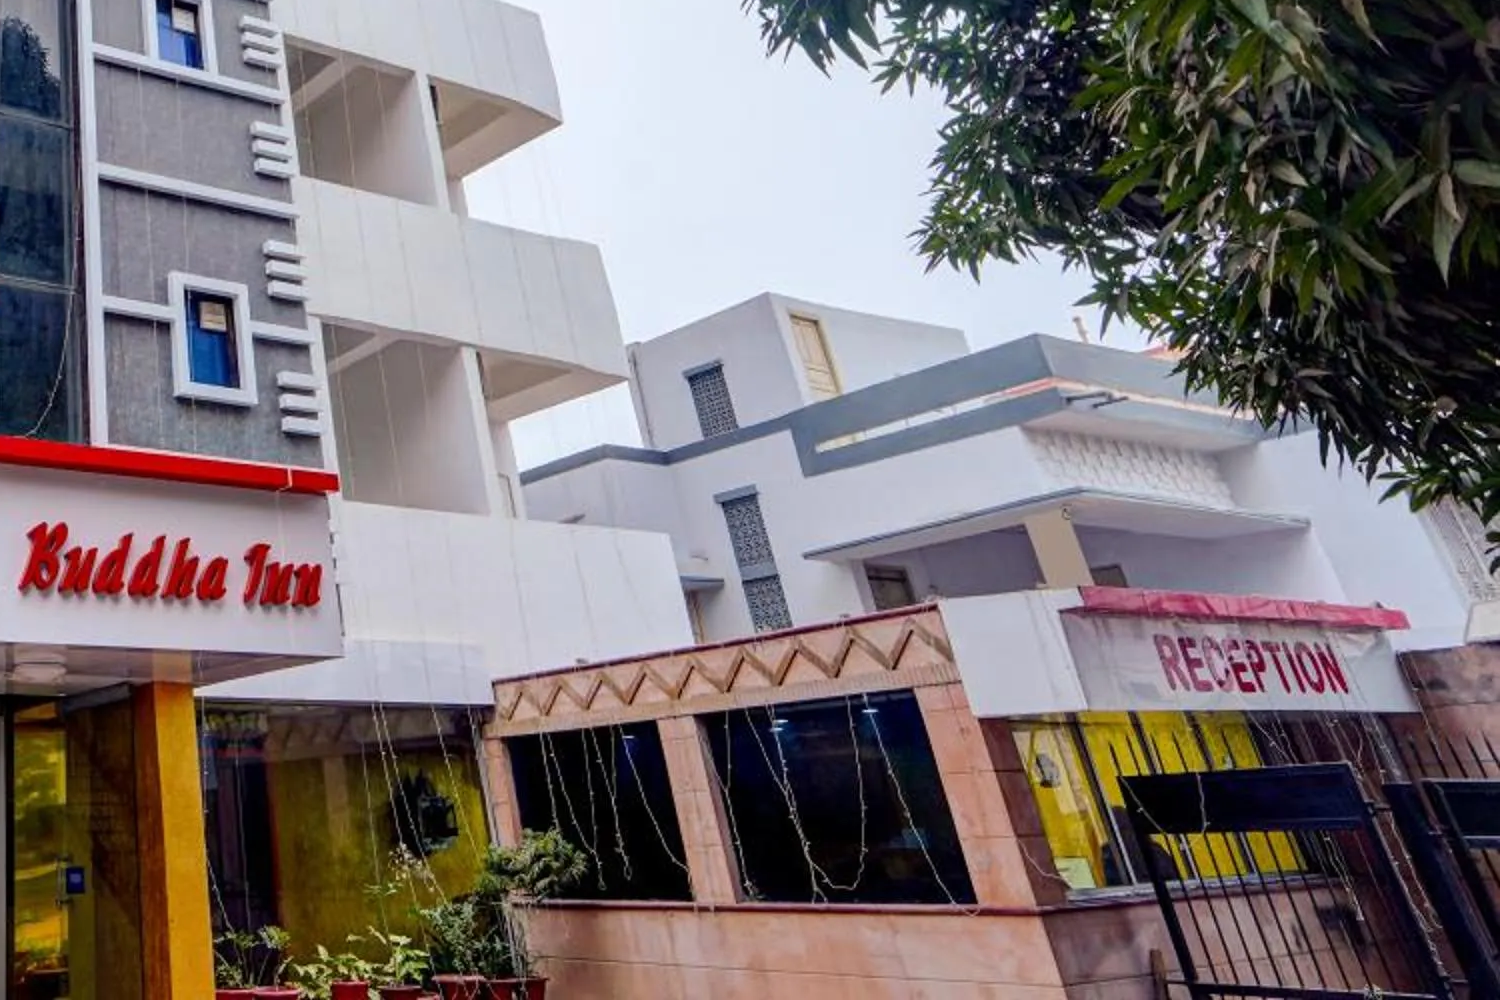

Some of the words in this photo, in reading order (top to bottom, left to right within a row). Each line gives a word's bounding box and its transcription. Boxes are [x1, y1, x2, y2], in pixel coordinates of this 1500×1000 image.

[18, 521, 229, 601] Buddha
[243, 543, 323, 607] Inn
[1153, 634, 1350, 695] RECEPTION
